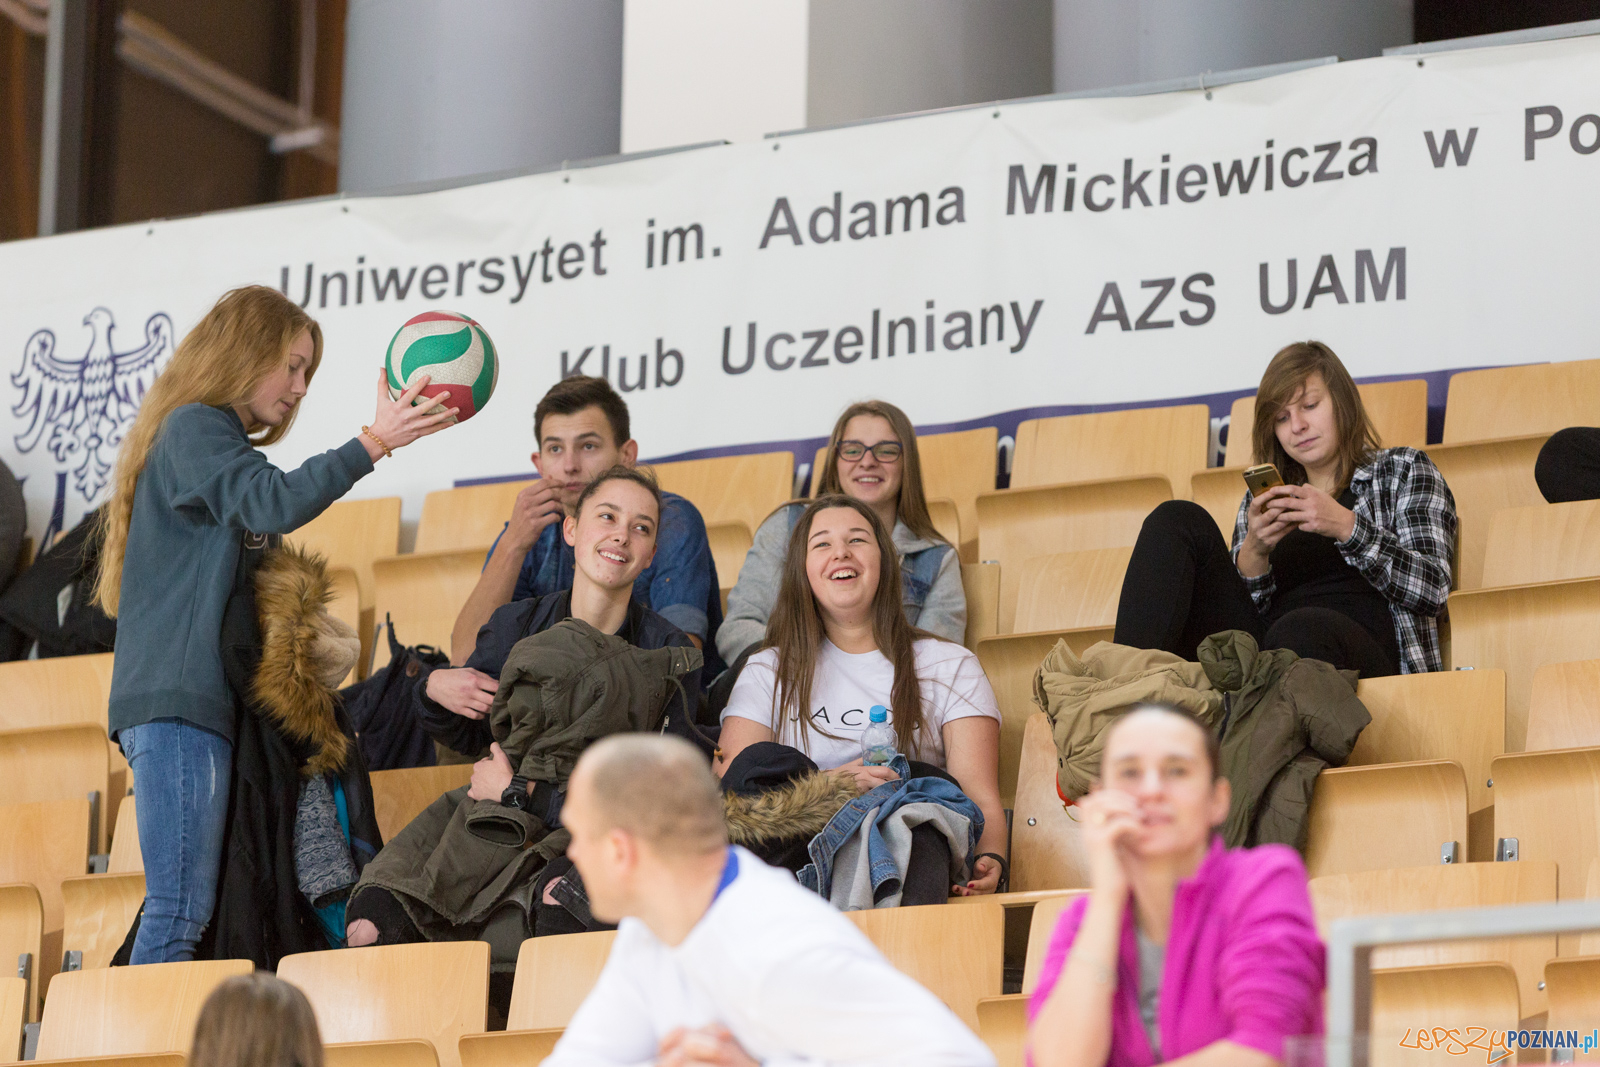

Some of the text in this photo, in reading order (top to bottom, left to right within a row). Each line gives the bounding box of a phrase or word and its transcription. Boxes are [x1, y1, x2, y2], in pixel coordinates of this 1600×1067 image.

[280, 229, 607, 310] Uniwersytet
[646, 218, 721, 269] im.
[758, 186, 966, 250] Adama
[1006, 137, 1379, 216] Mickiewicza
[1424, 127, 1479, 169] w
[561, 246, 1407, 393] Klub Uczelniany AZS UAM
